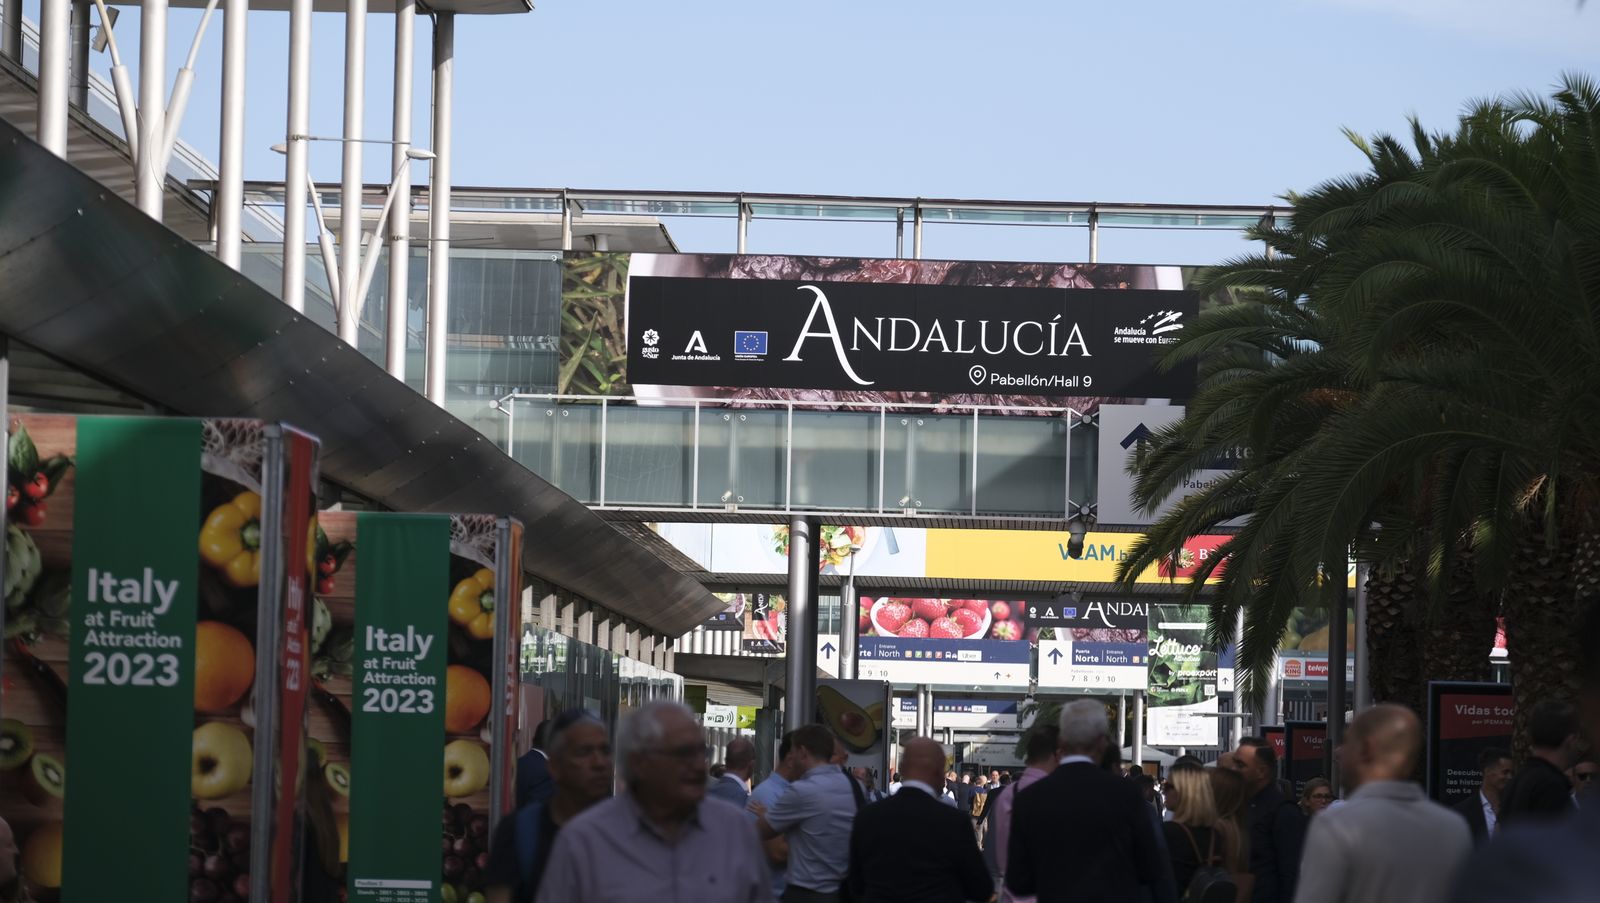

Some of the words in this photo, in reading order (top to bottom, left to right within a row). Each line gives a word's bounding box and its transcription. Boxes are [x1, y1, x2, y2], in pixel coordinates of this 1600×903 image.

[782, 284, 1092, 385] ANDALUCÍA
[1114, 327, 1147, 335] Andalucía
[990, 372, 1079, 388] Pabellón/Hall
[1082, 374, 1092, 388] 9
[88, 568, 179, 614] Italy
[84, 612, 105, 627] at
[110, 611, 155, 628] Fruit
[84, 630, 182, 648] Attraction
[365, 625, 434, 660] Italy
[1149, 635, 1201, 657] Lettuce
[879, 650, 900, 658] North
[1075, 654, 1099, 663] Norte
[1106, 654, 1128, 664] North
[83, 652, 180, 687] 2023
[363, 658, 379, 670] at
[383, 657, 416, 670] Fruit
[363, 672, 436, 685] Attraction
[868, 670, 873, 678] 9
[880, 670, 888, 678] 10
[1071, 674, 1076, 682] 7
[362, 688, 435, 713] 2023
[1455, 704, 1490, 716] Vidas
[1446, 788, 1461, 796] que
